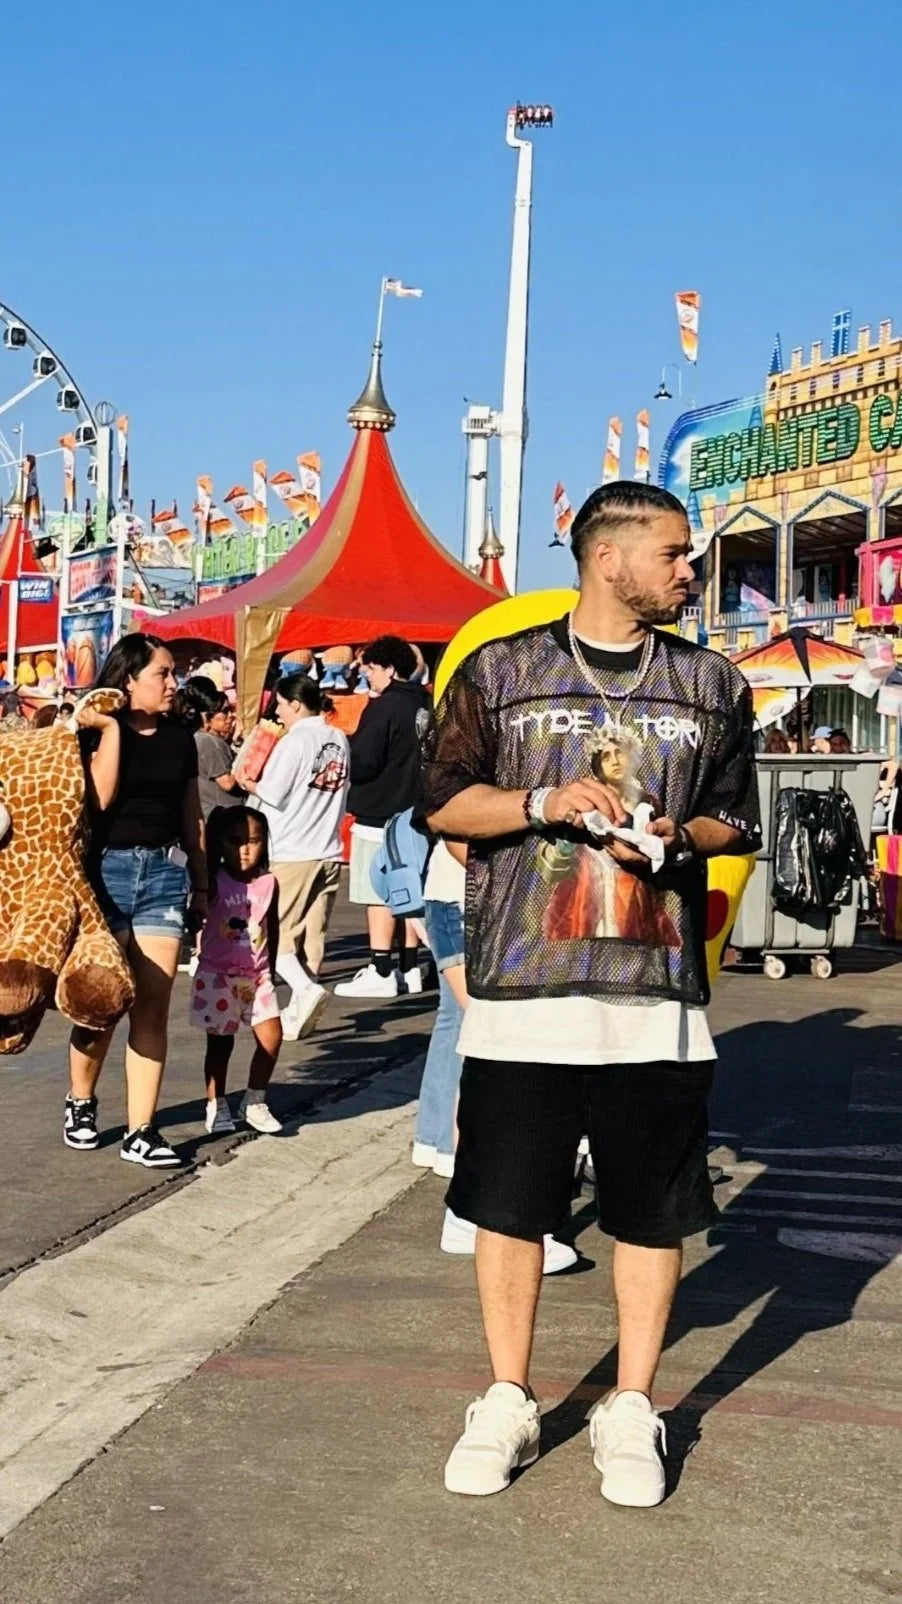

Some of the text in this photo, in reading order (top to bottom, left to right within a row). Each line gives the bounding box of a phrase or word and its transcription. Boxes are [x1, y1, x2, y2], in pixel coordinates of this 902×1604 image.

[689, 402, 861, 491] ENCHANTED
[20, 580, 49, 590] WIN
[20, 589, 49, 599] BIG!
[718, 810, 747, 830] HAVE
